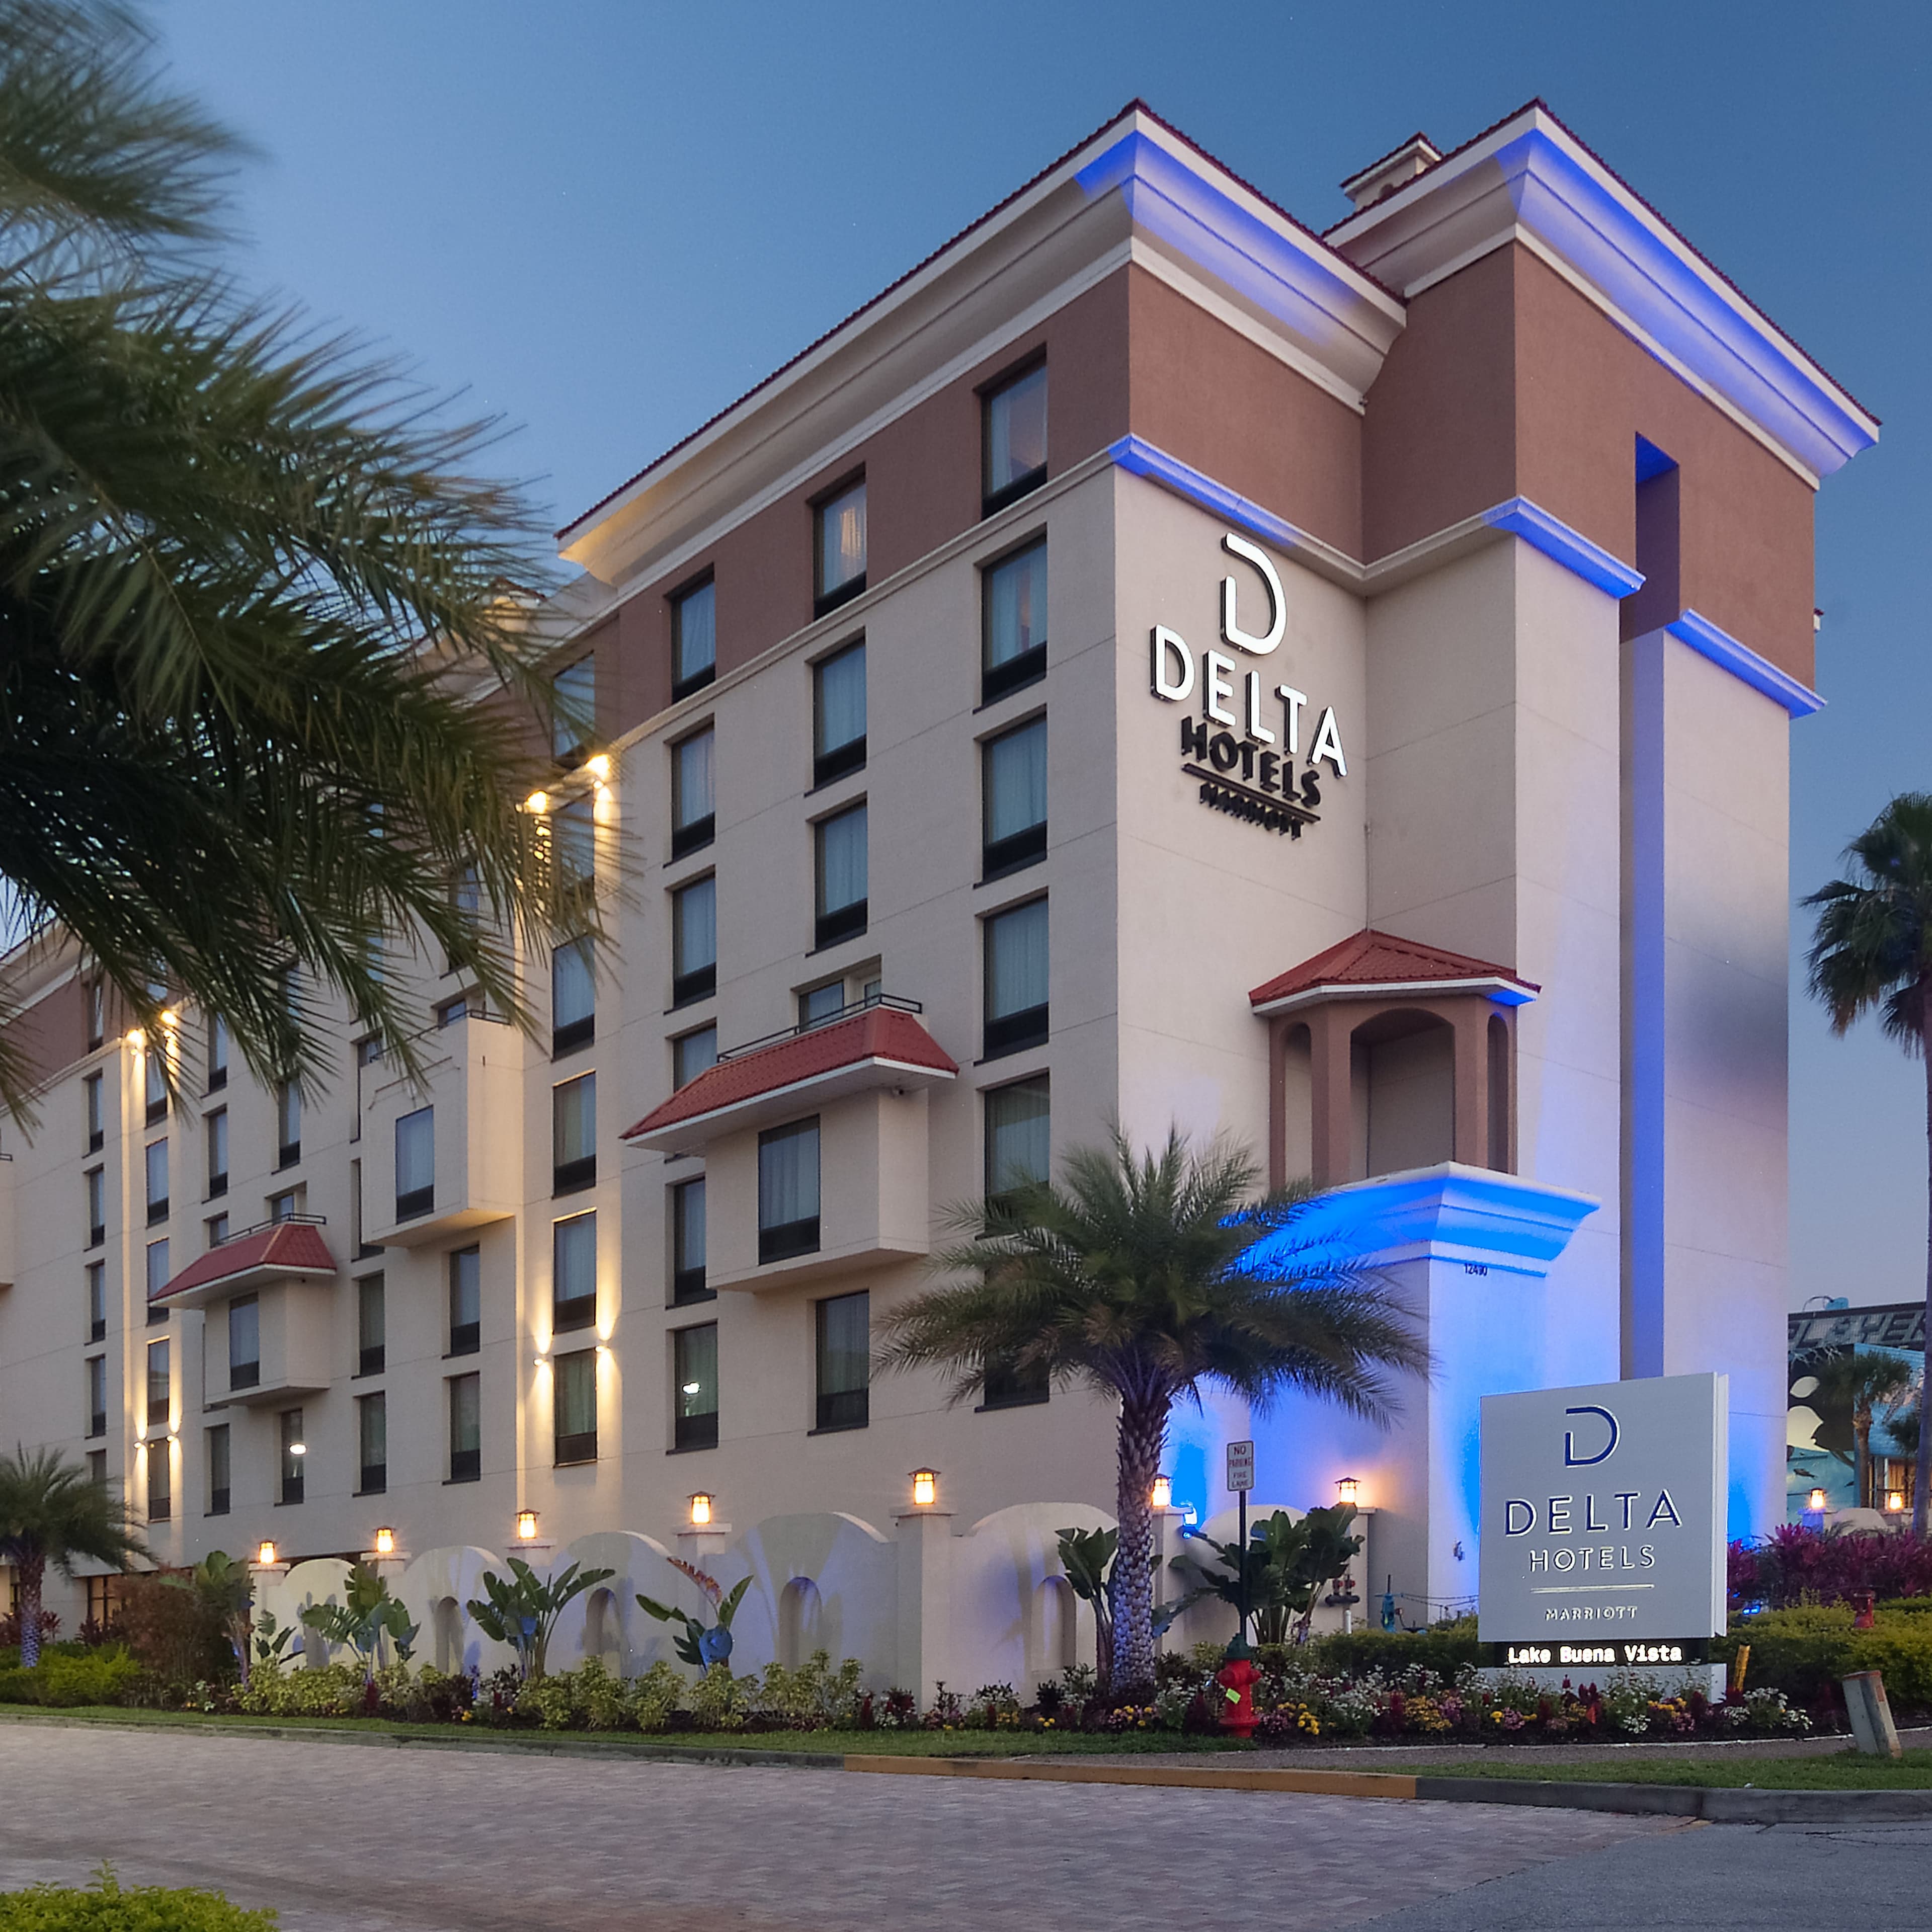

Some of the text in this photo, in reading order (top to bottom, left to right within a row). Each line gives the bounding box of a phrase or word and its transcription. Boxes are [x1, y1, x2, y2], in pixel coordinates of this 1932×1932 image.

[1150, 624, 1347, 778] DELTA
[1181, 716, 1321, 809] HOTELS
[1199, 781, 1304, 841] MOTT
[1234, 1445, 1246, 1455] NO
[1505, 1488, 1682, 1537] DELTA
[1530, 1544, 1655, 1572] HOTELS
[1545, 1605, 1638, 1621] MARRIOTT
[1508, 1644, 1682, 1664] Lake Buena Vista
